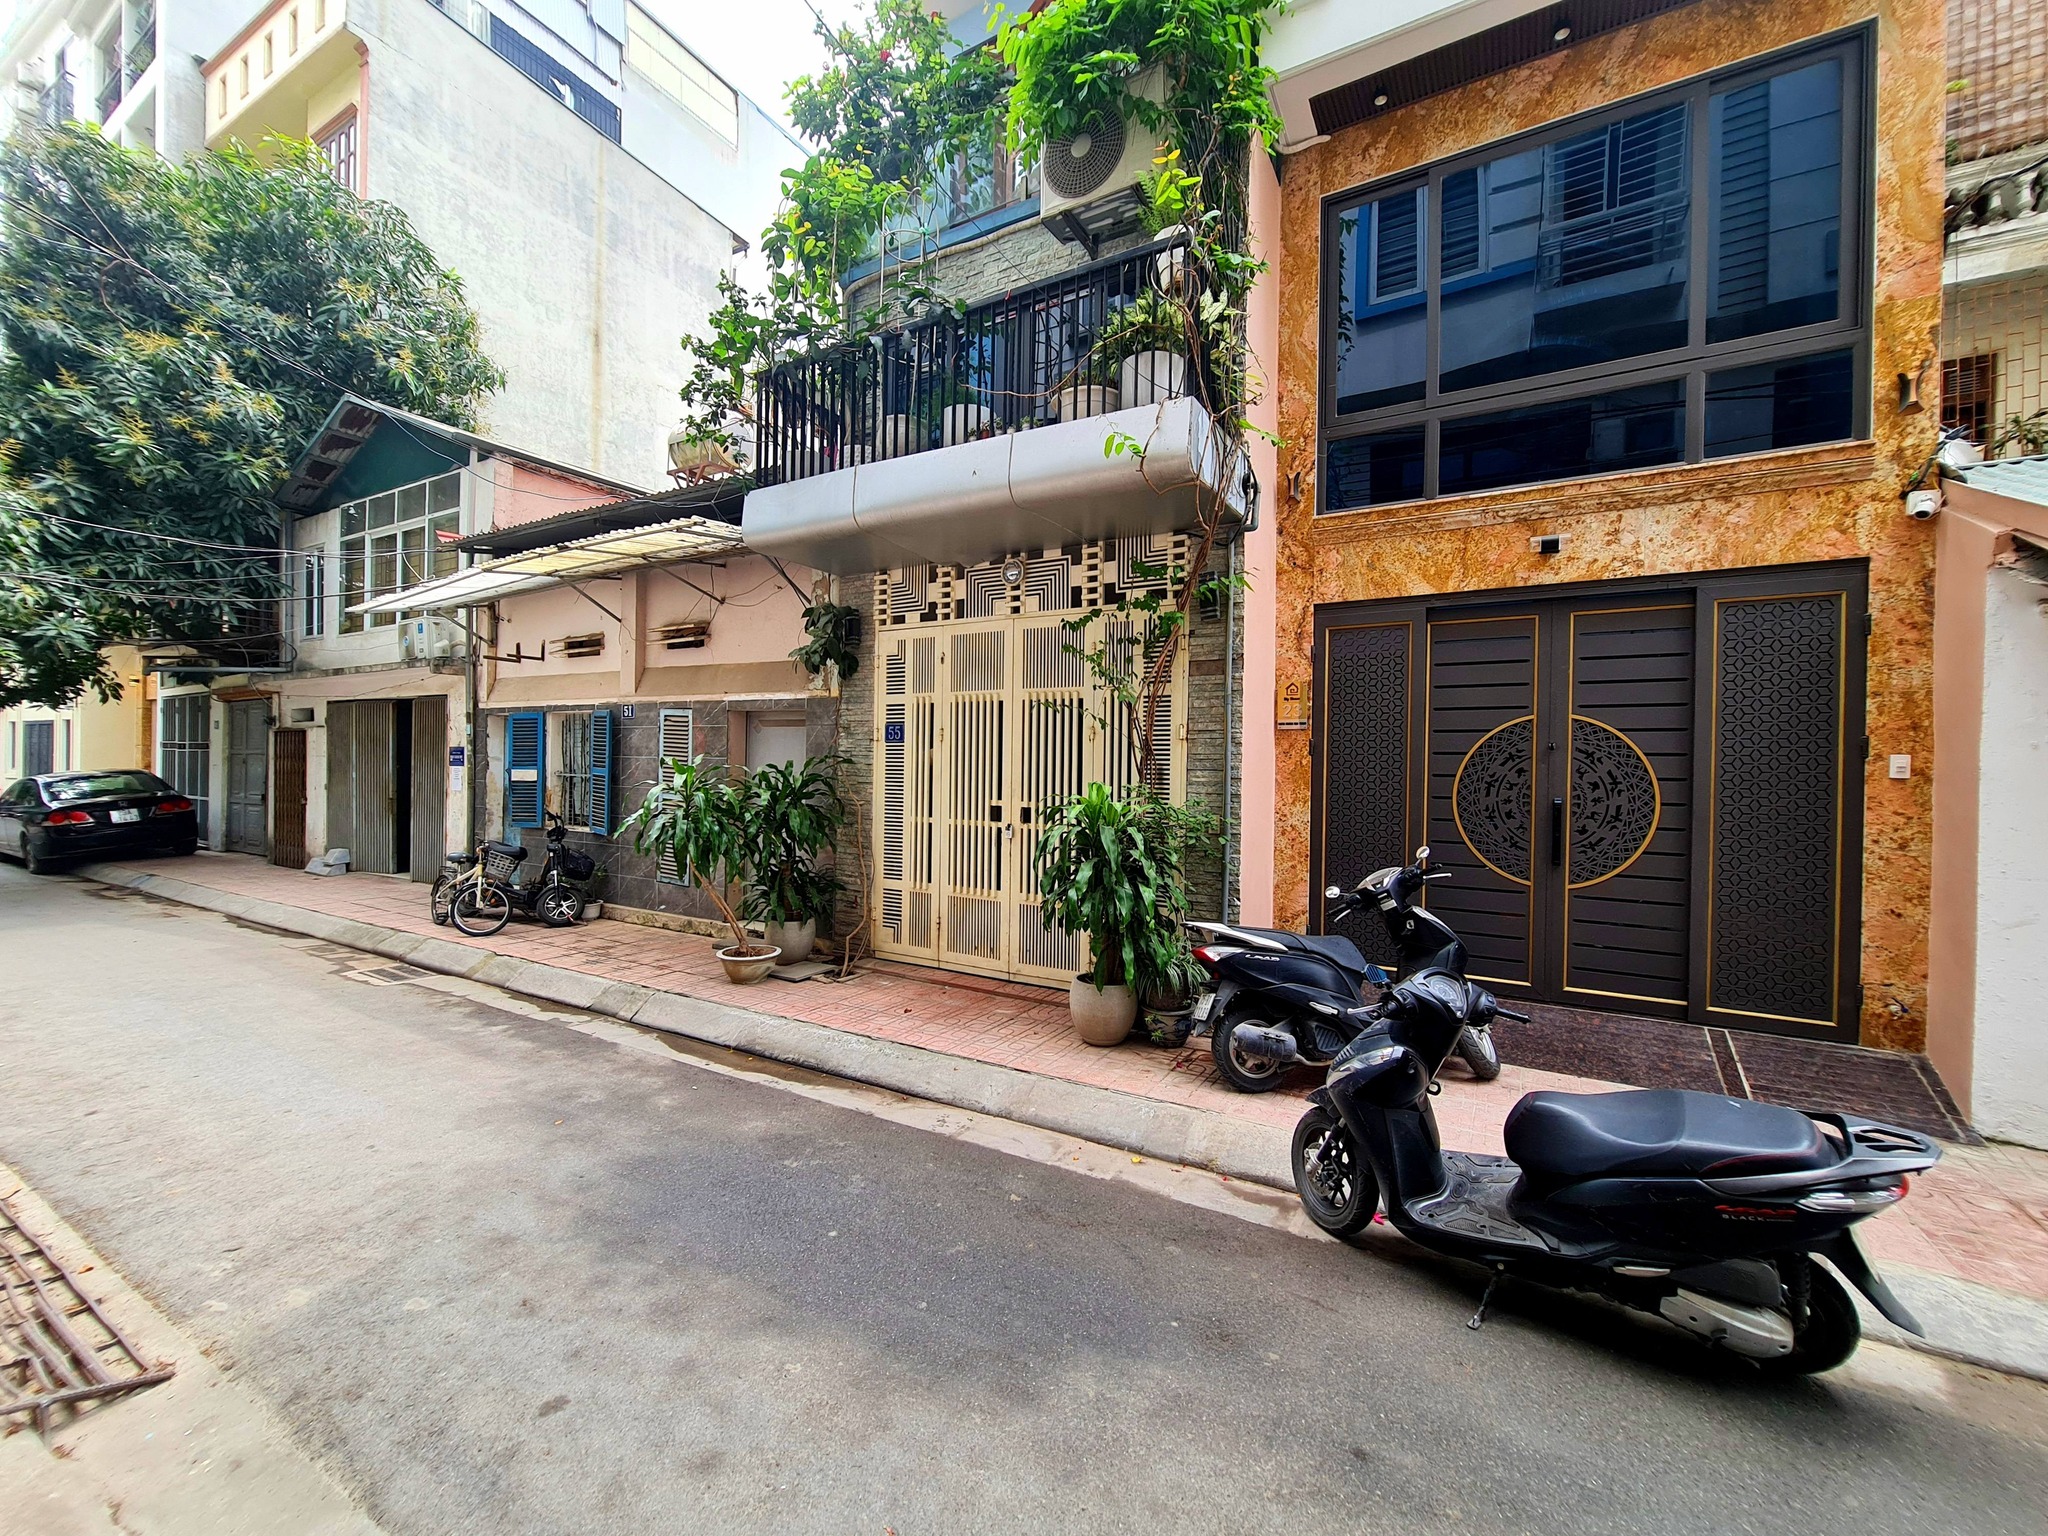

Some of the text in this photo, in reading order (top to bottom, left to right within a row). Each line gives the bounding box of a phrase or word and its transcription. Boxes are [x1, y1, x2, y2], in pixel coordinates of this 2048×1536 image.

[623, 705, 633, 717] 51
[1283, 704, 1302, 718] 23
[888, 726, 901, 739] 55
[1721, 1213, 1764, 1221] BLACK
